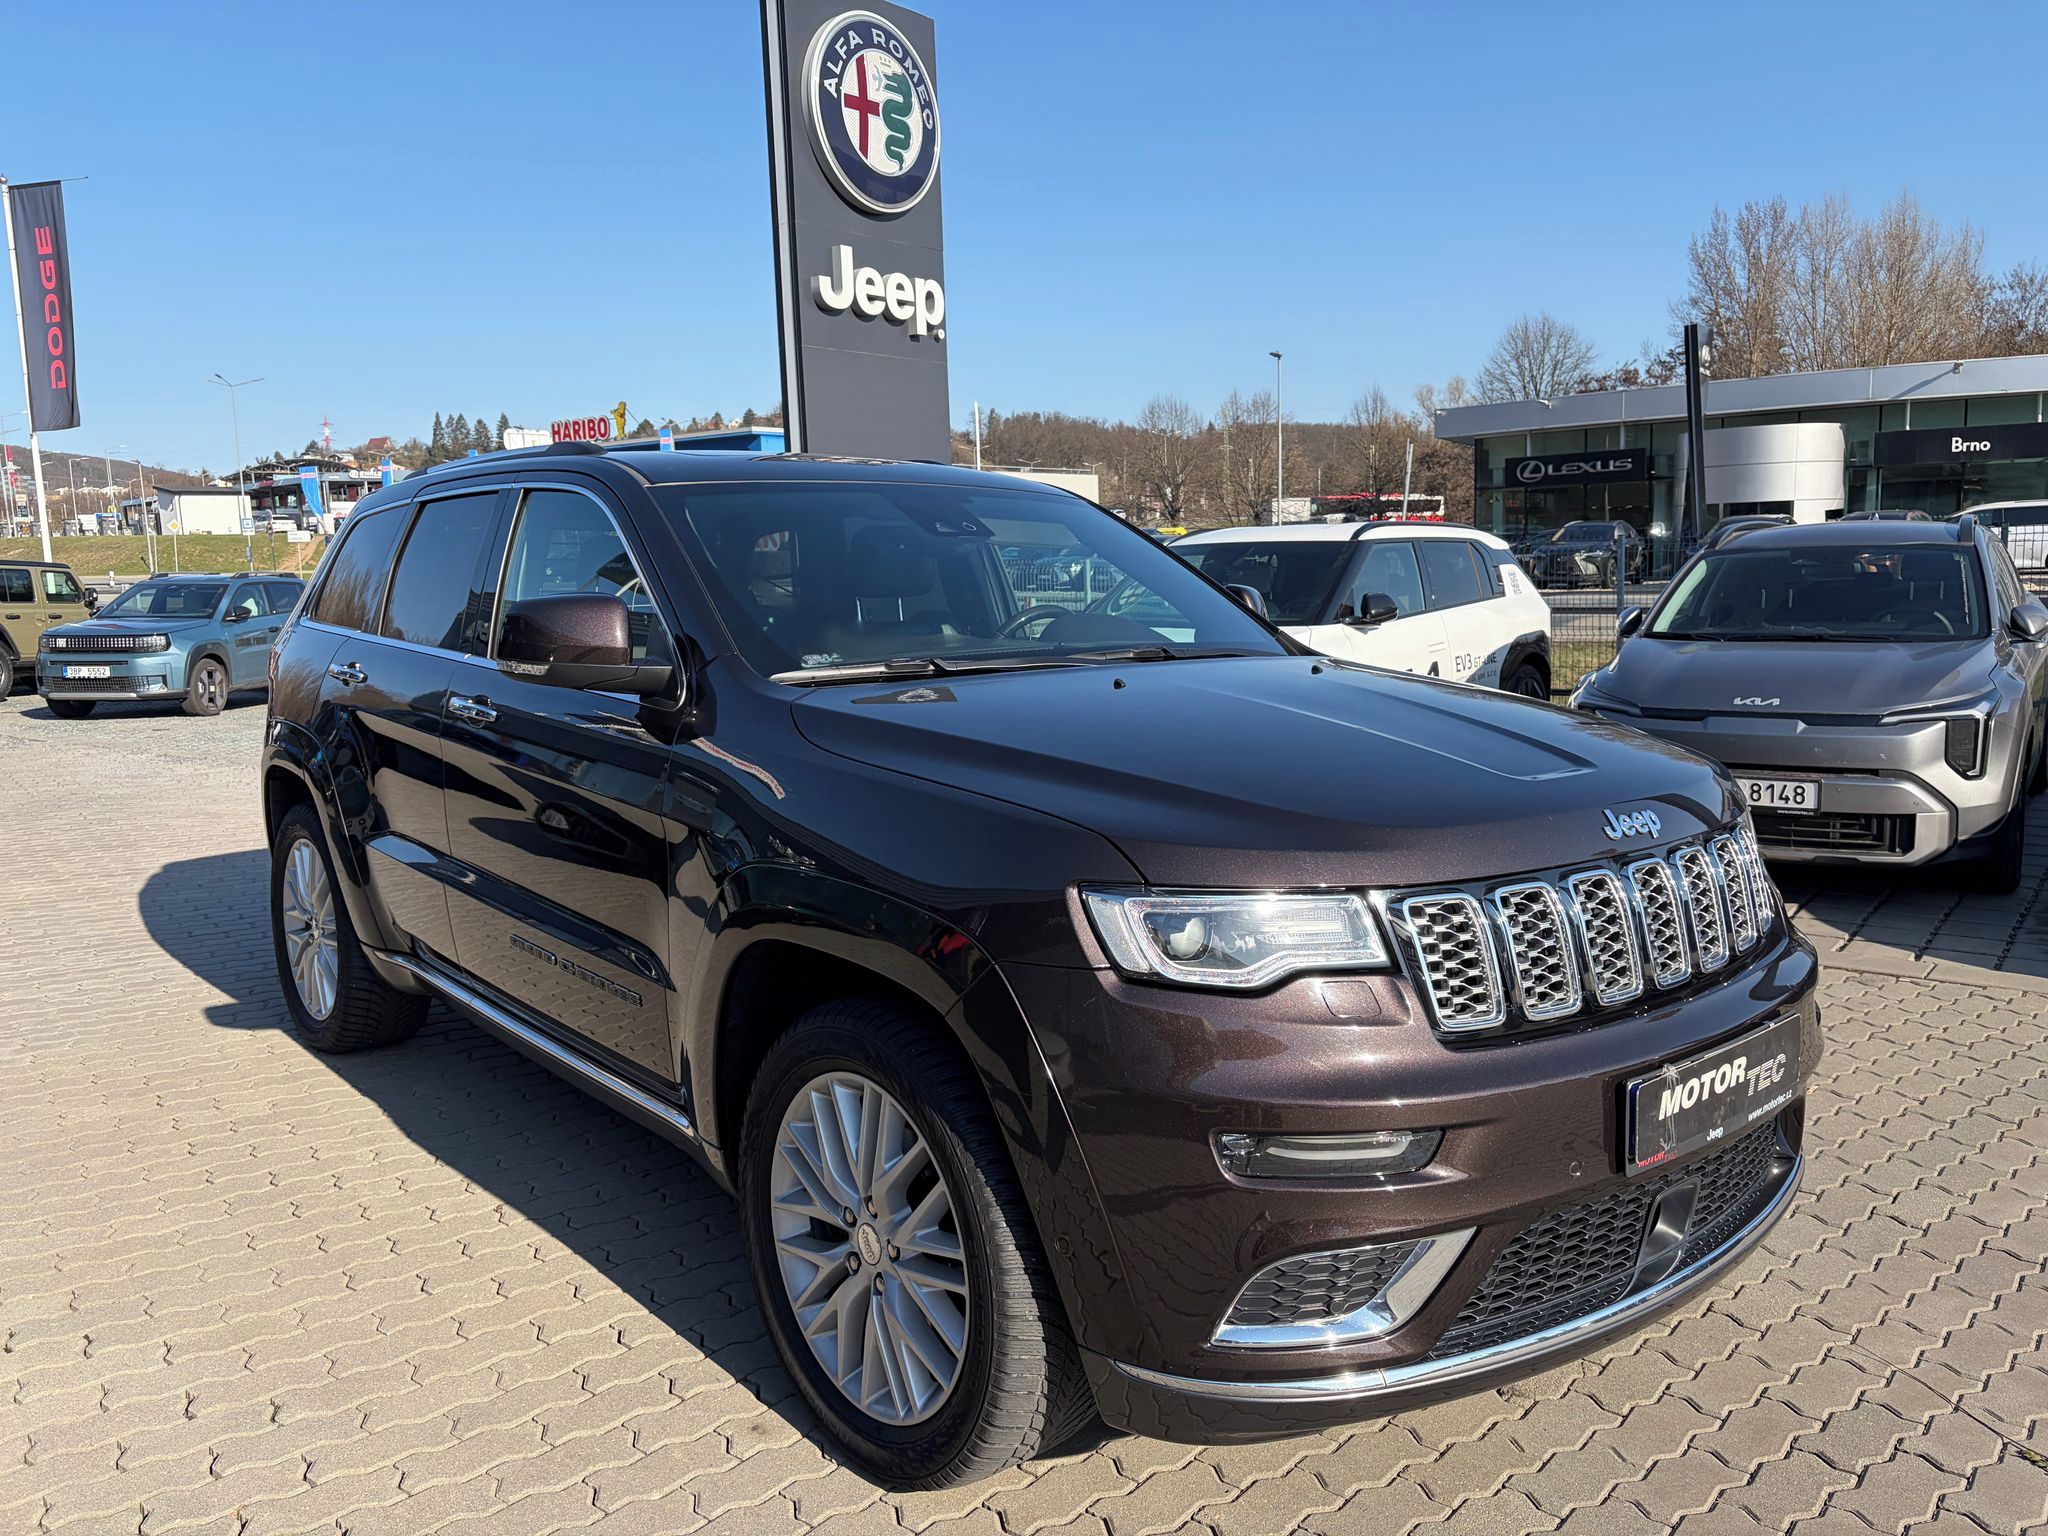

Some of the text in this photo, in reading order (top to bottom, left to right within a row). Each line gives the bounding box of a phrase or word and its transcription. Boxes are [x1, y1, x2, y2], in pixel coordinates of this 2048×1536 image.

[822, 27, 934, 131] ALFA ROMEO
[812, 244, 945, 337] Jeep
[34, 226, 67, 389] DODGE
[551, 415, 610, 442] HARIBO
[1951, 436, 1991, 453] Brno
[1547, 458, 1632, 476] LEXUS
[87, 667, 107, 676] 5552
[1454, 653, 1473, 673] EV3
[1733, 696, 1781, 707] KIA
[1750, 782, 1806, 805] 8148
[1602, 808, 1661, 840] Jeep
[1658, 1053, 1787, 1121] MOTOR TEC
[1747, 1089, 1793, 1122] www.motortec.cz
[1706, 1126, 1724, 1141] Jeep
